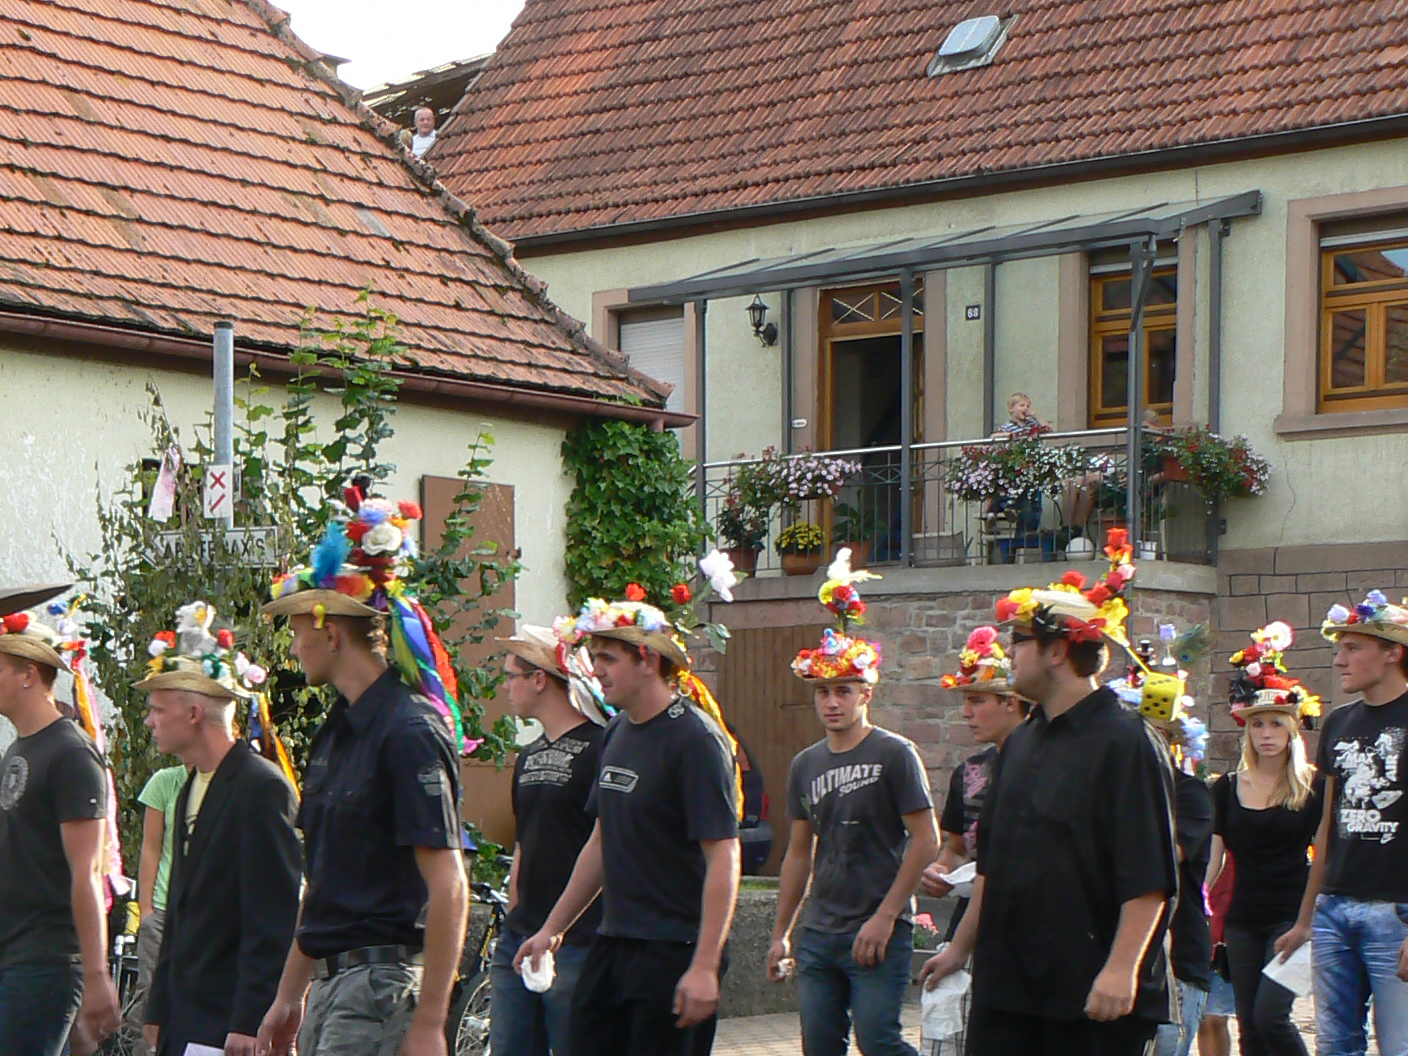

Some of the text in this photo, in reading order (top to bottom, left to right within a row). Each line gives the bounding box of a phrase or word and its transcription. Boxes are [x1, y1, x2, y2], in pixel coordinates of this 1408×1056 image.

[809, 763, 884, 806] ULTIMATE
[838, 776, 880, 798] SOUND
[1339, 808, 1382, 823] ZERO
[1346, 821, 1400, 833] GRAVITY
